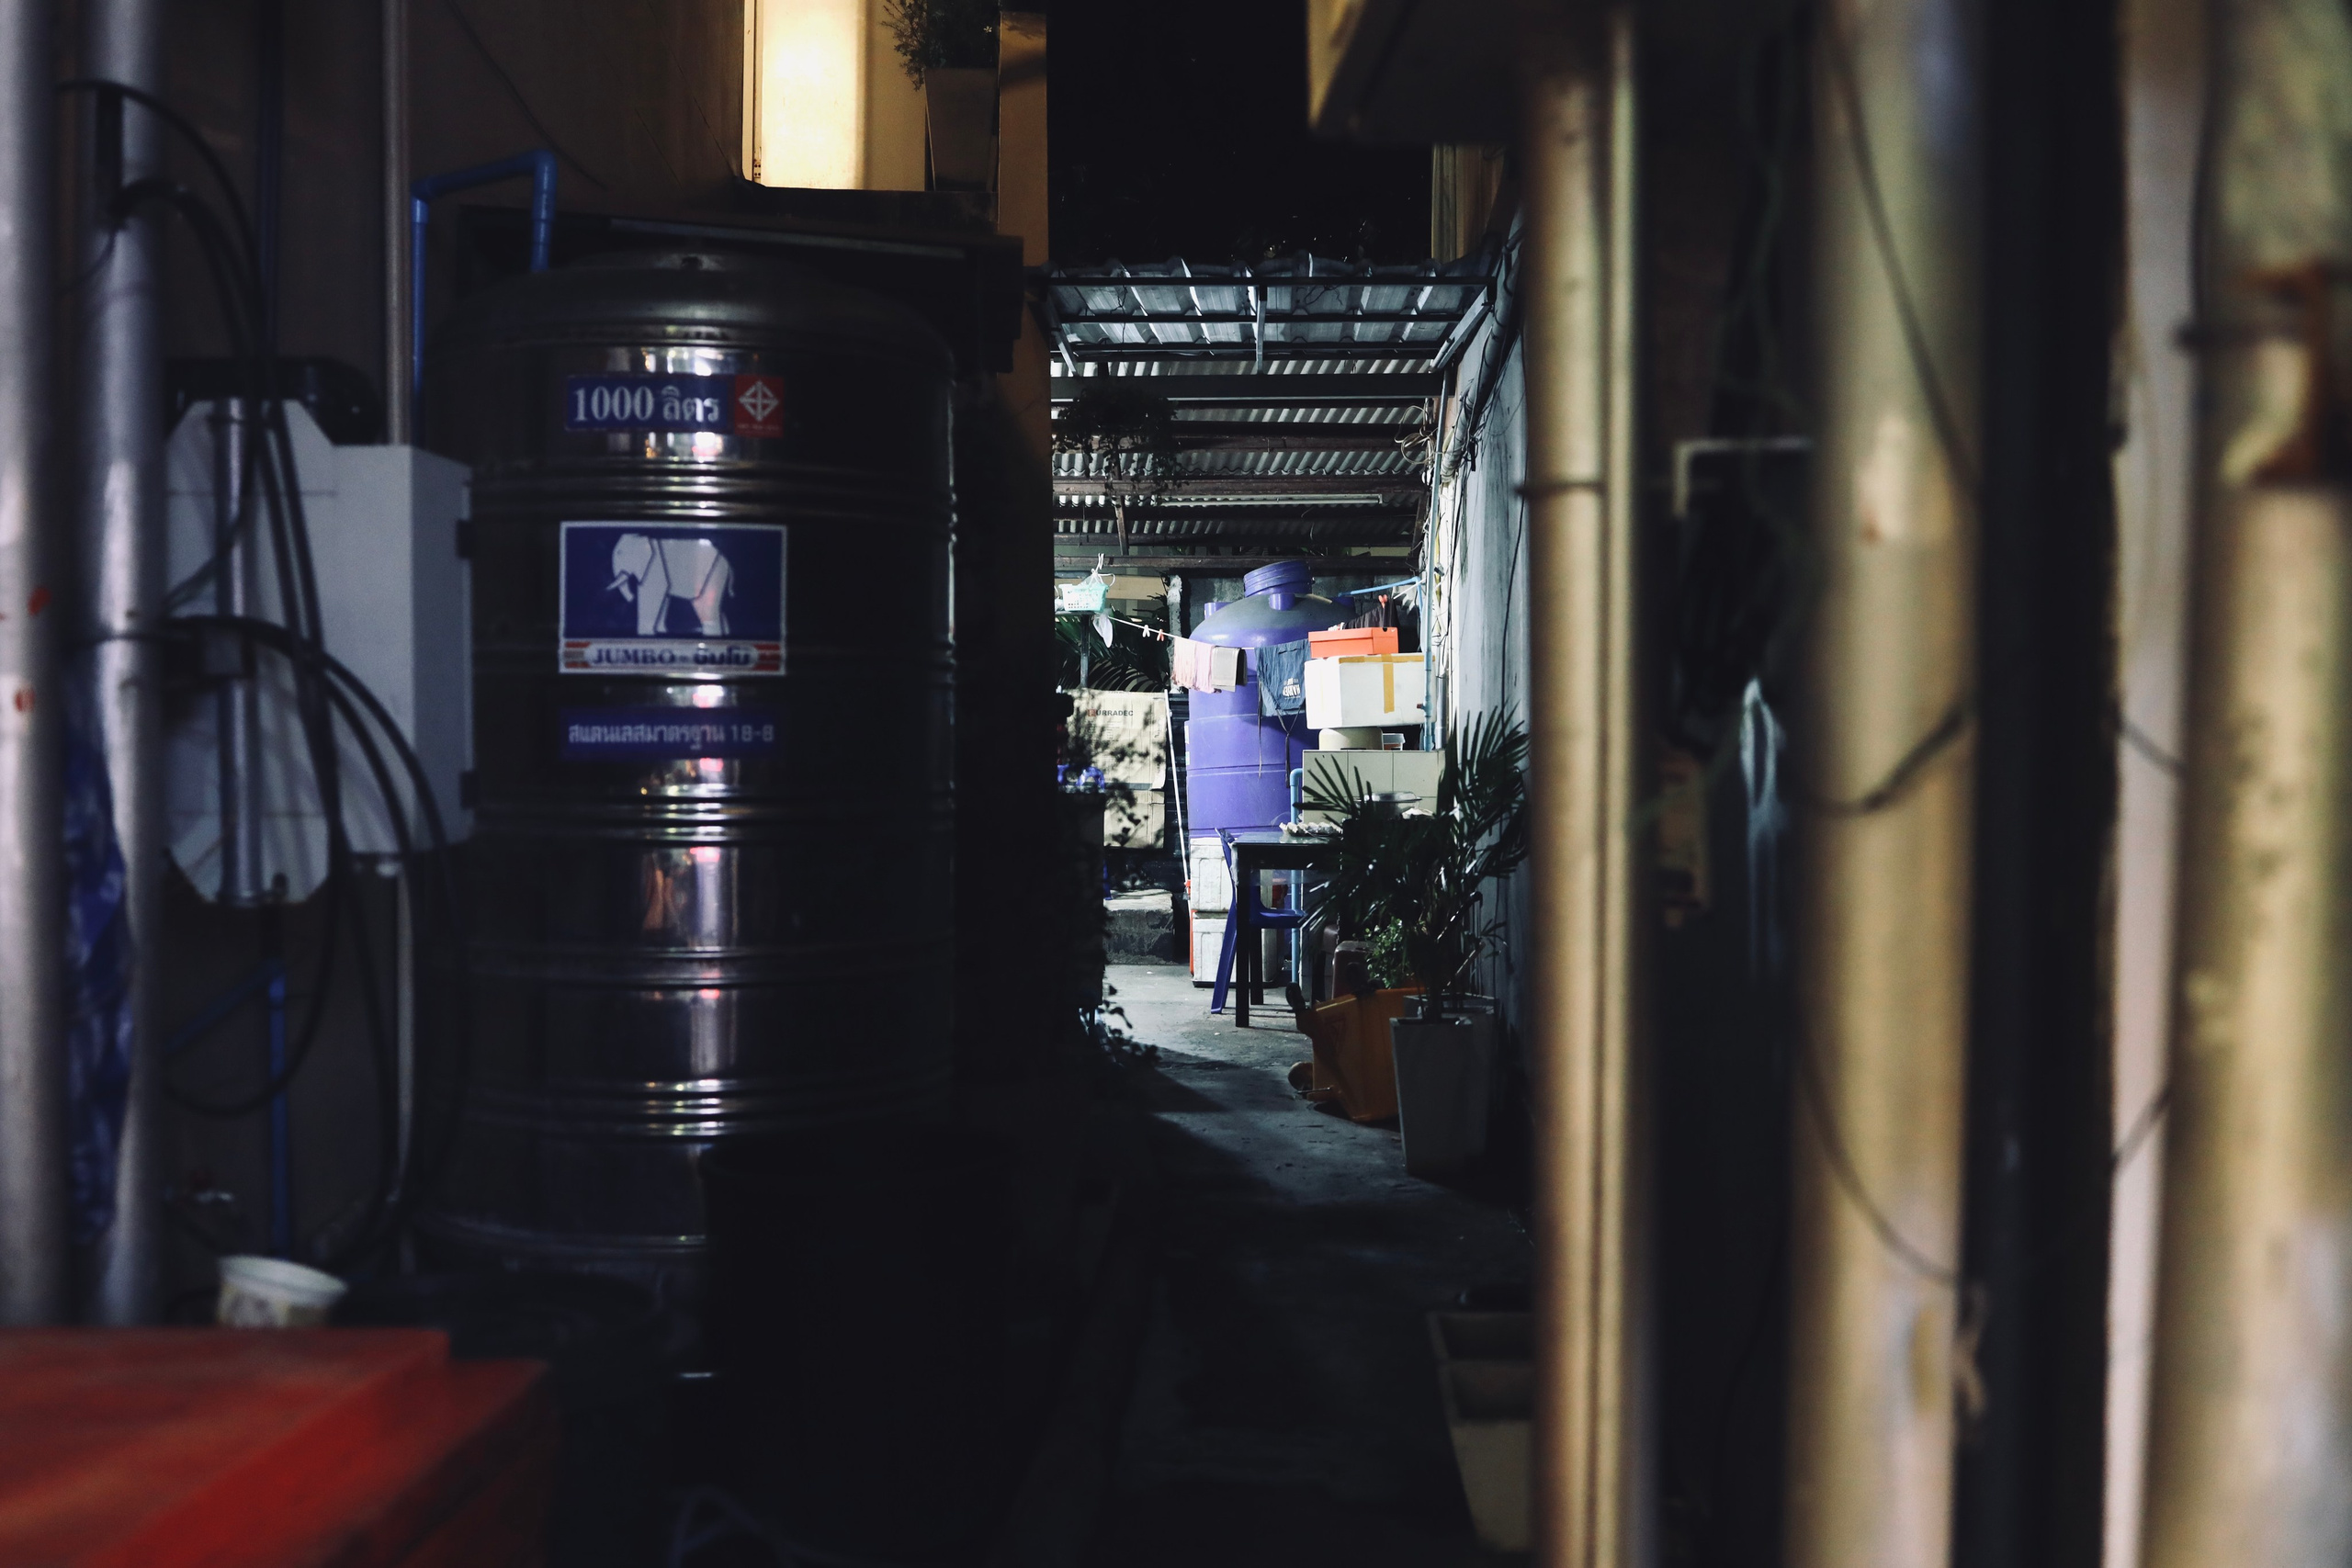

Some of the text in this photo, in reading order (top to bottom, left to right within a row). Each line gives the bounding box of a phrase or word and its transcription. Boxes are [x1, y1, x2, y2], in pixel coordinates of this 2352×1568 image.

[573, 384, 720, 423] 1000 ลิตร
[593, 648, 676, 665] JUMBO
[729, 724, 775, 743] 18-8
